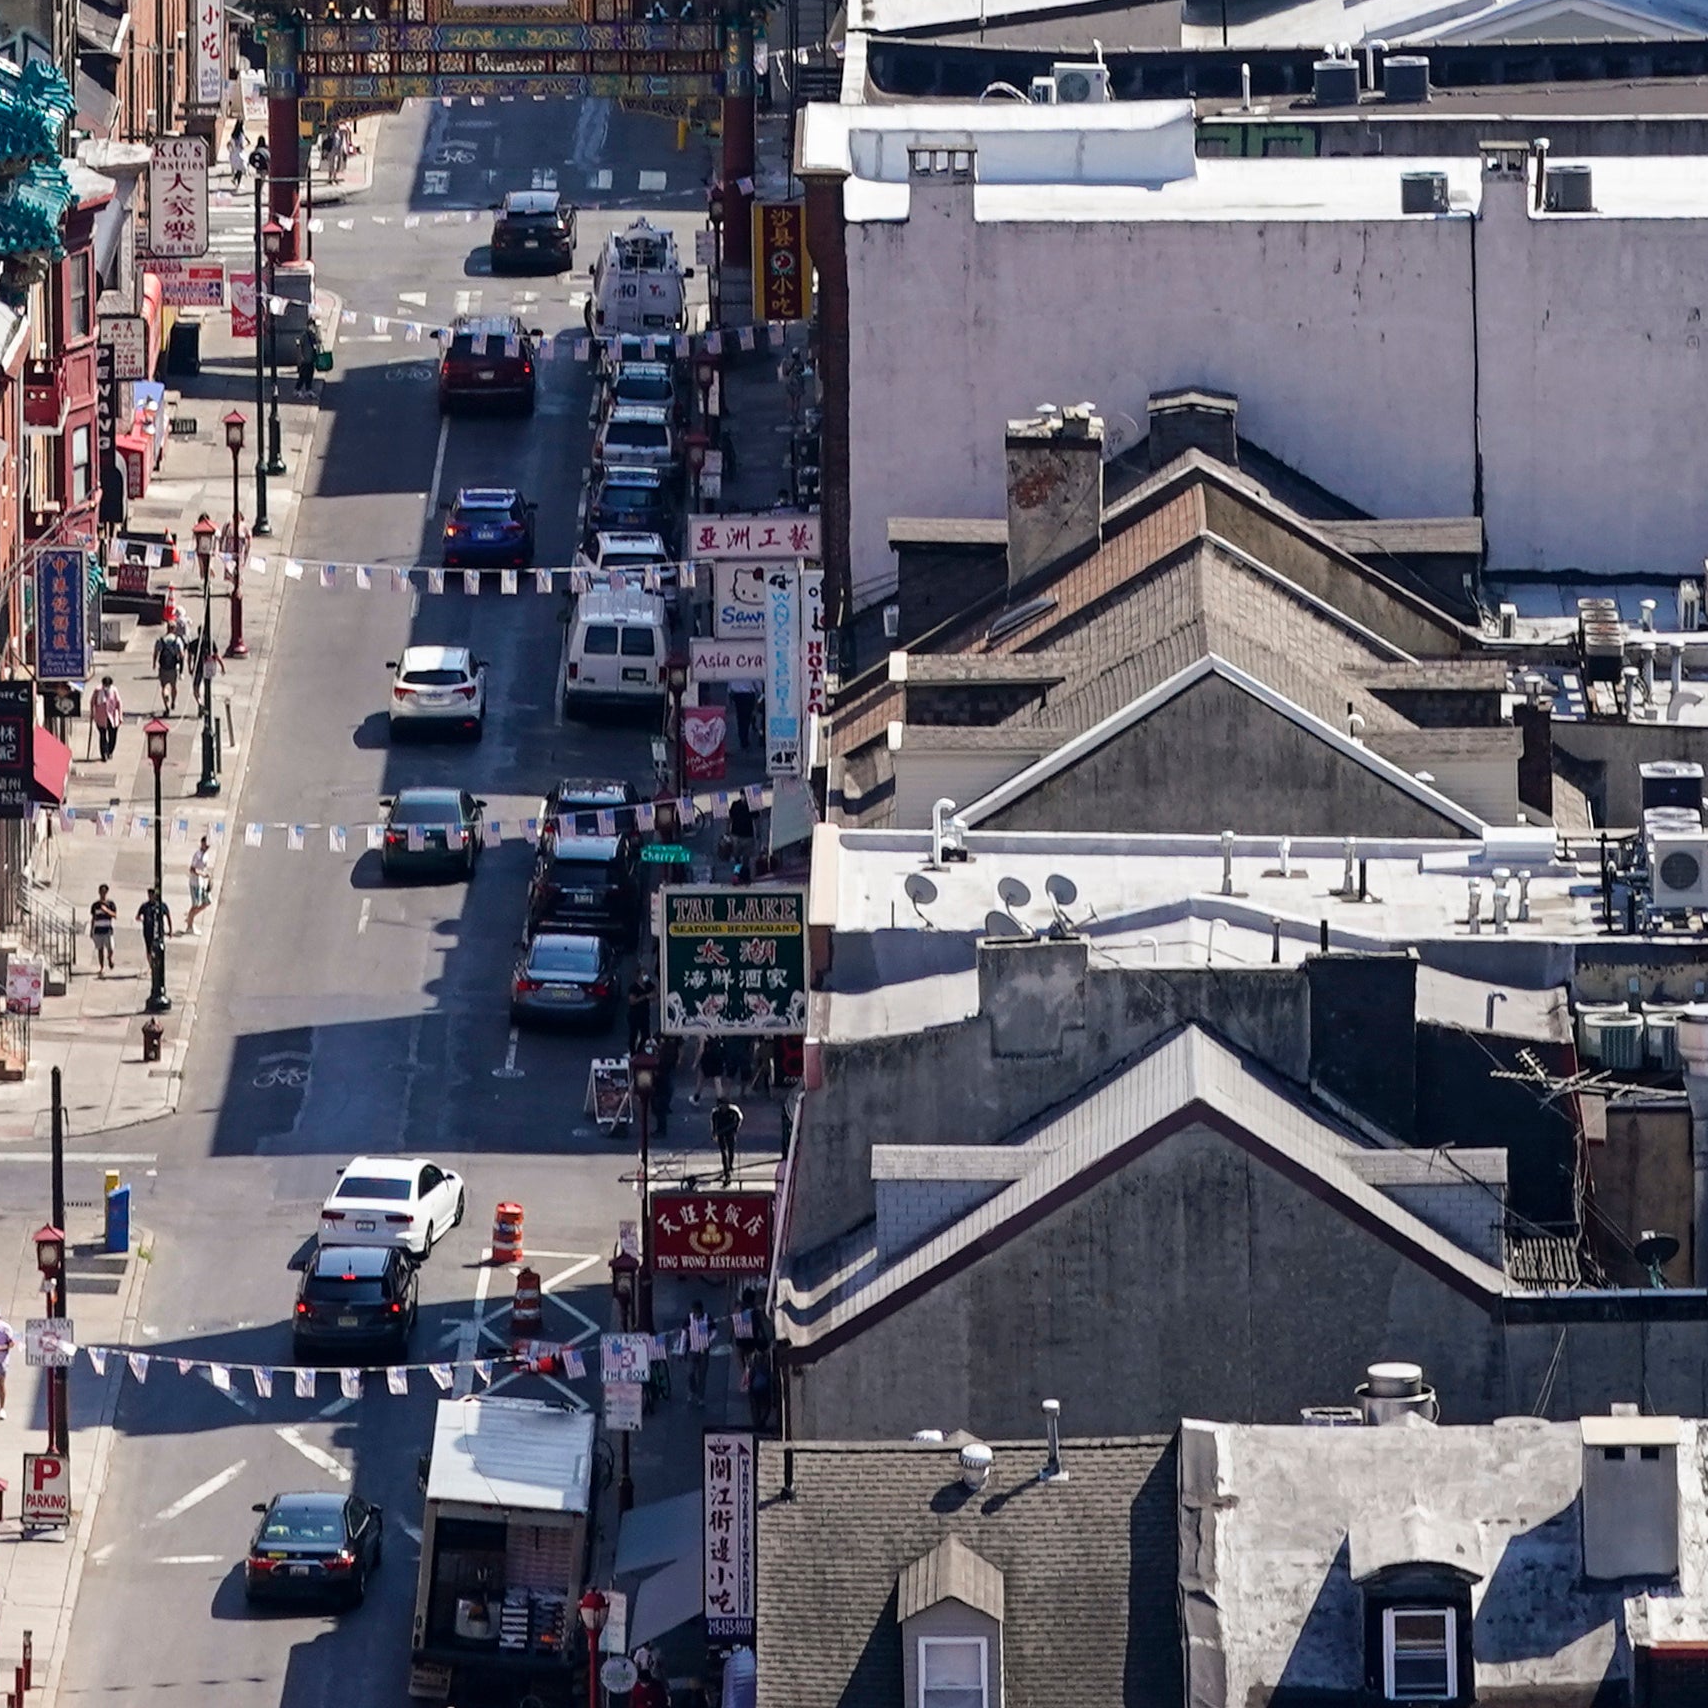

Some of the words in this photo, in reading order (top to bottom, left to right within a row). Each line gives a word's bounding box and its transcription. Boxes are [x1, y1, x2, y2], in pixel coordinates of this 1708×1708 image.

[154, 142, 203, 158] K.C.'s
[152, 160, 205, 171] Pastries
[695, 651, 730, 669] Asia
[18, 688, 29, 703] C
[641, 850, 675, 863] Cherry
[680, 852, 690, 862] St
[673, 897, 714, 922] TAI
[727, 897, 797, 922] LAKE
[672, 924, 723, 933] SEAFOOD
[727, 924, 797, 933] RESTAURANT
[694, 937, 777, 966] 太湖
[683, 968, 788, 990] 海鮮酒家
[657, 1255, 678, 1269] TING
[681, 1255, 707, 1269] WONG
[709, 1255, 765, 1269] RESTAURANT
[29, 1354, 49, 1365] THE
[51, 1354, 72, 1365] BOX
[33, 1458, 62, 1491] P
[26, 1493, 67, 1509] PARKING
